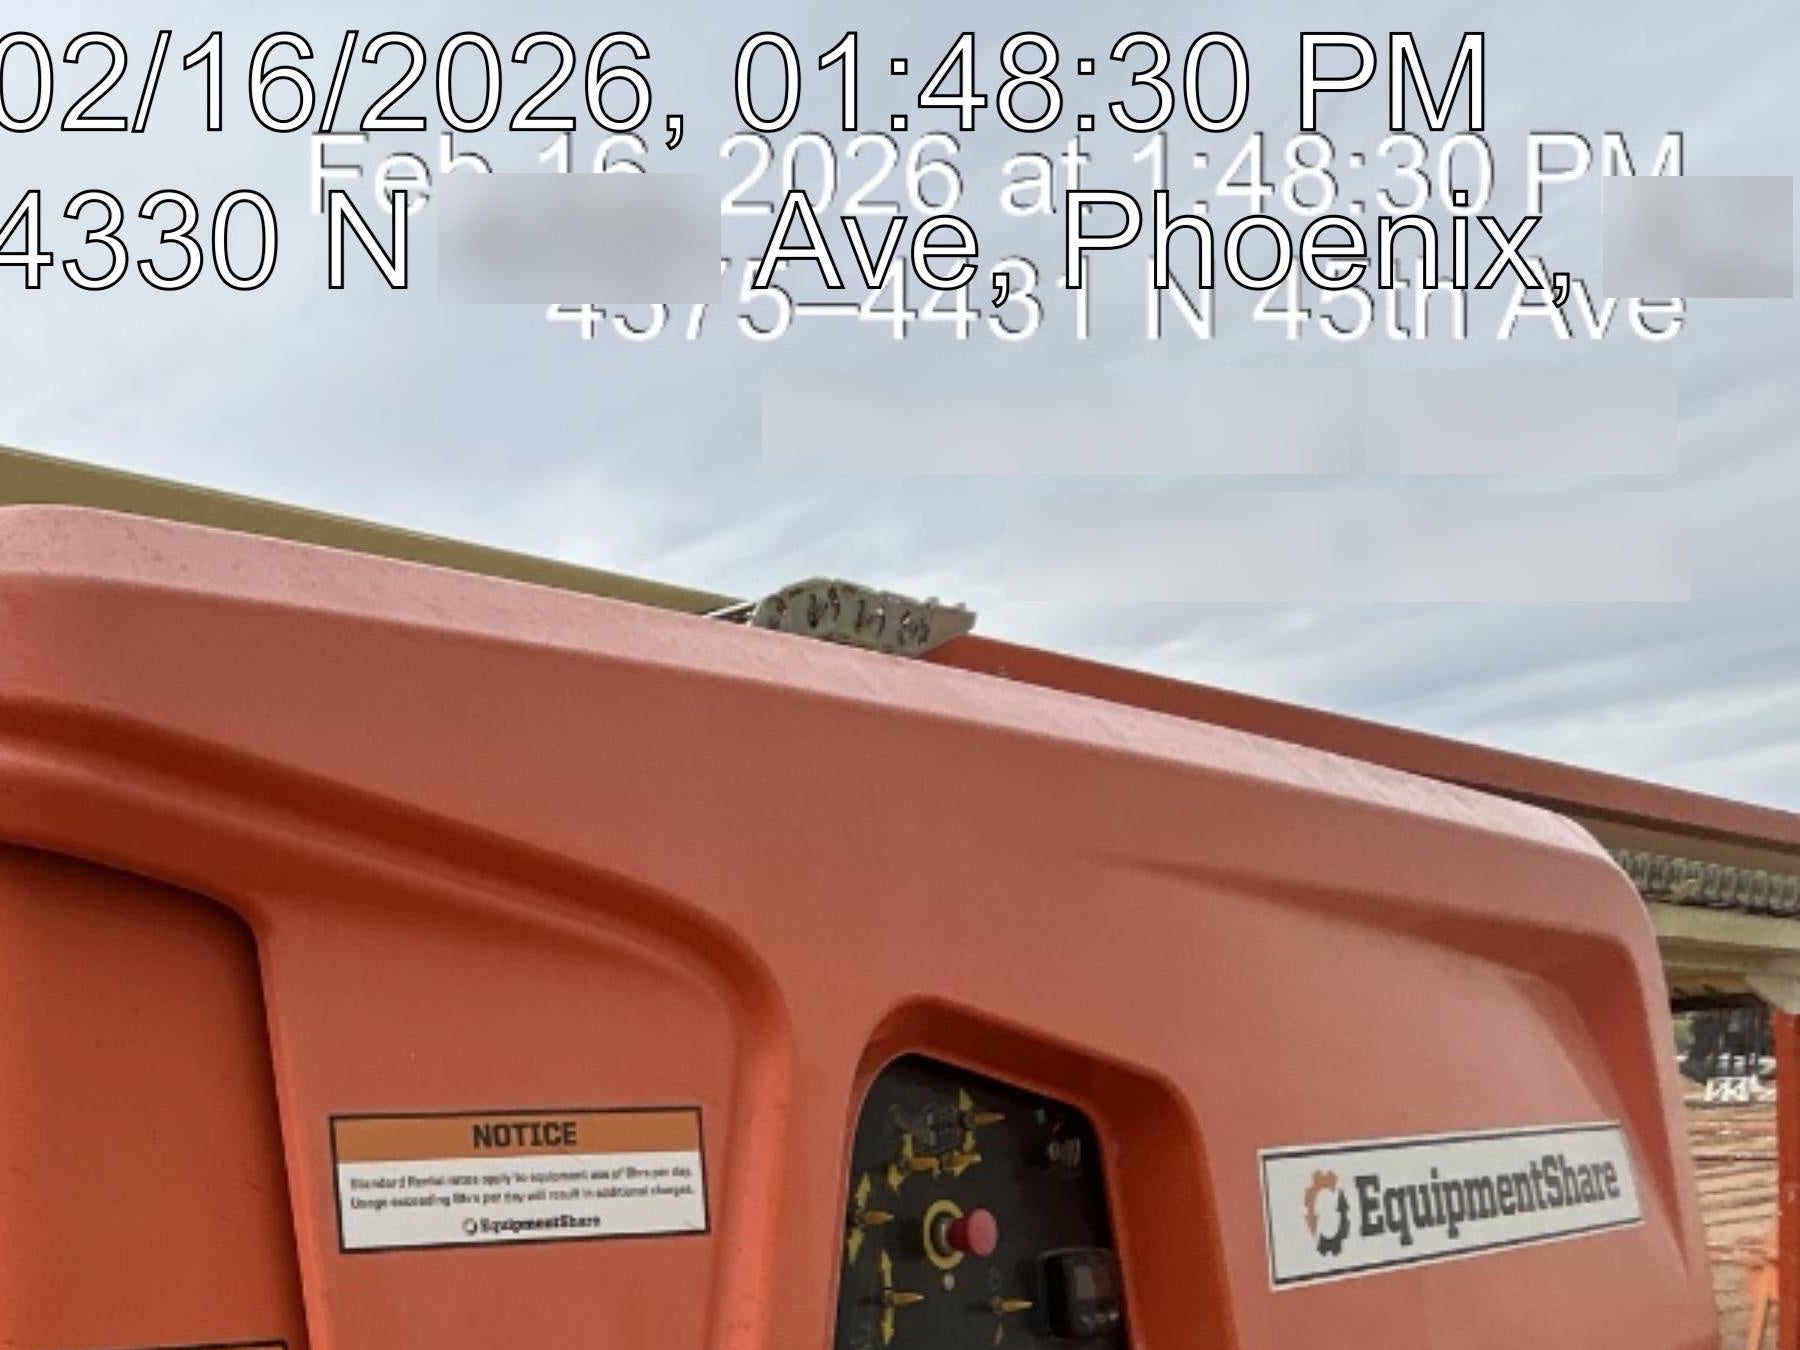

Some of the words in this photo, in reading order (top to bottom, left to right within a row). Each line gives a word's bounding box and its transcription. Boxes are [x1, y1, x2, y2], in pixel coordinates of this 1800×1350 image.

[472, 1121, 578, 1150] NOTICE
[1355, 1154, 1621, 1246] EquipmentShare
[479, 1213, 601, 1234] EquipmentShare
